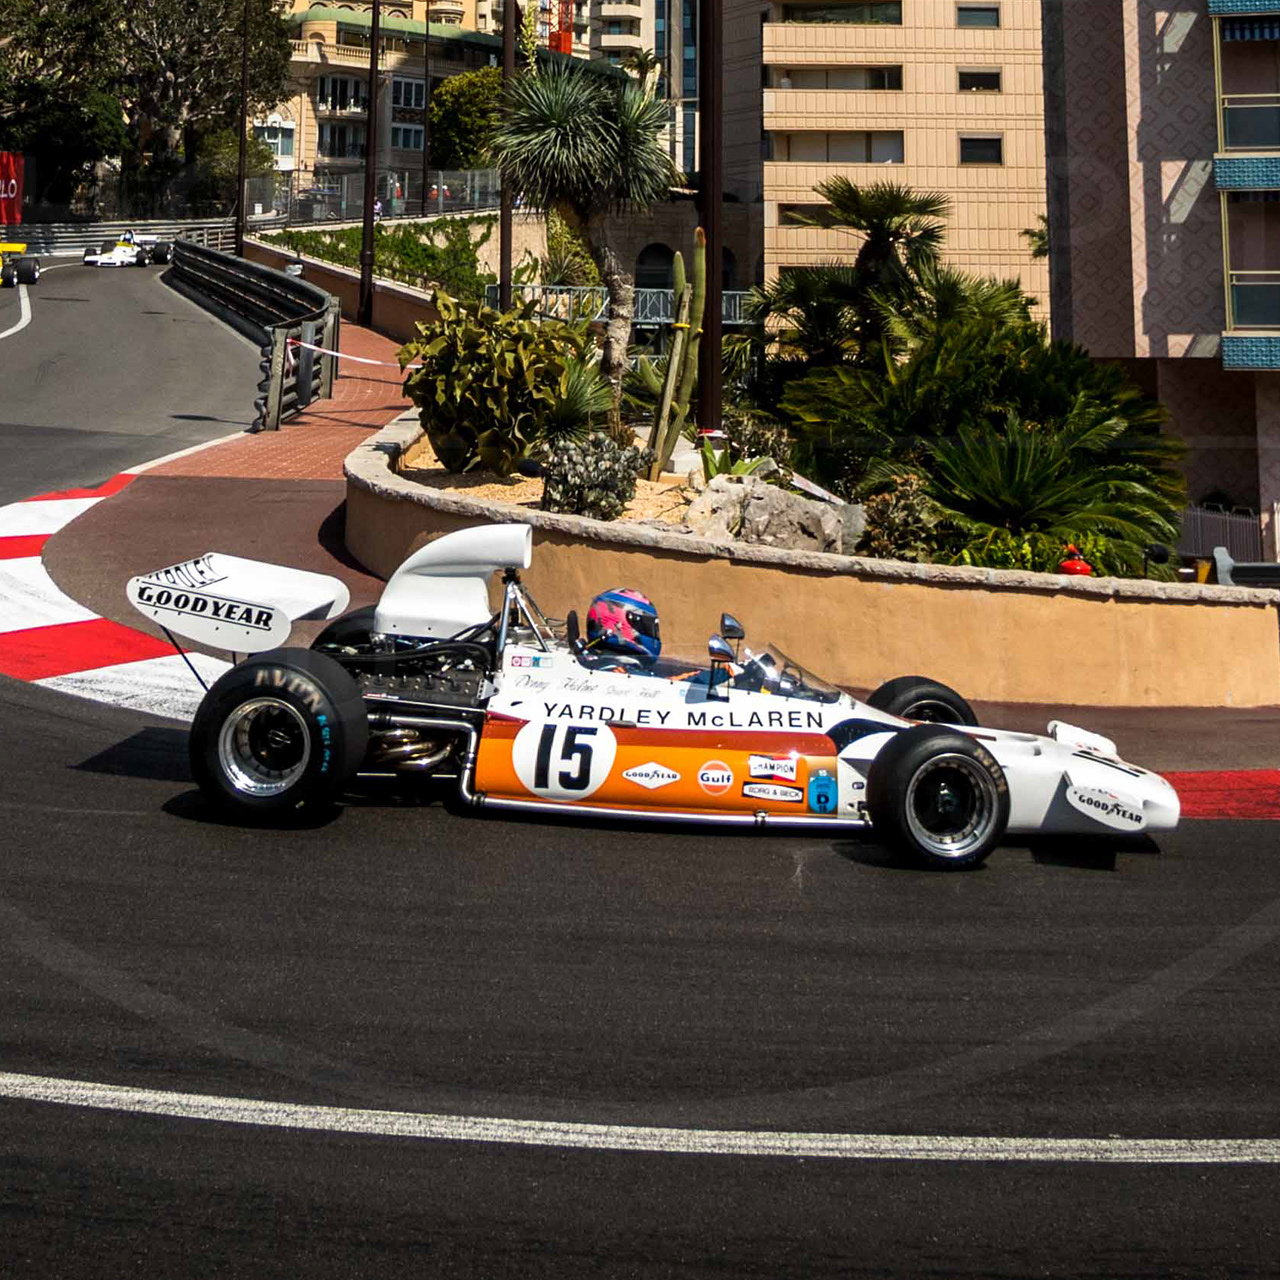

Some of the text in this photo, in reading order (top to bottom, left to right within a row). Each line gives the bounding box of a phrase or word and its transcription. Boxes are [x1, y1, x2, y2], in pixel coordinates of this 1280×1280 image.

[137, 586, 274, 628] GOODYEAR
[254, 669, 324, 713] AVON
[544, 702, 824, 729] YARDLEY McLAREN
[534, 723, 598, 791] 15
[624, 769, 679, 780] GOODYEAR
[700, 771, 732, 784] Gulf
[1078, 794, 1143, 825] GOODYEAR
